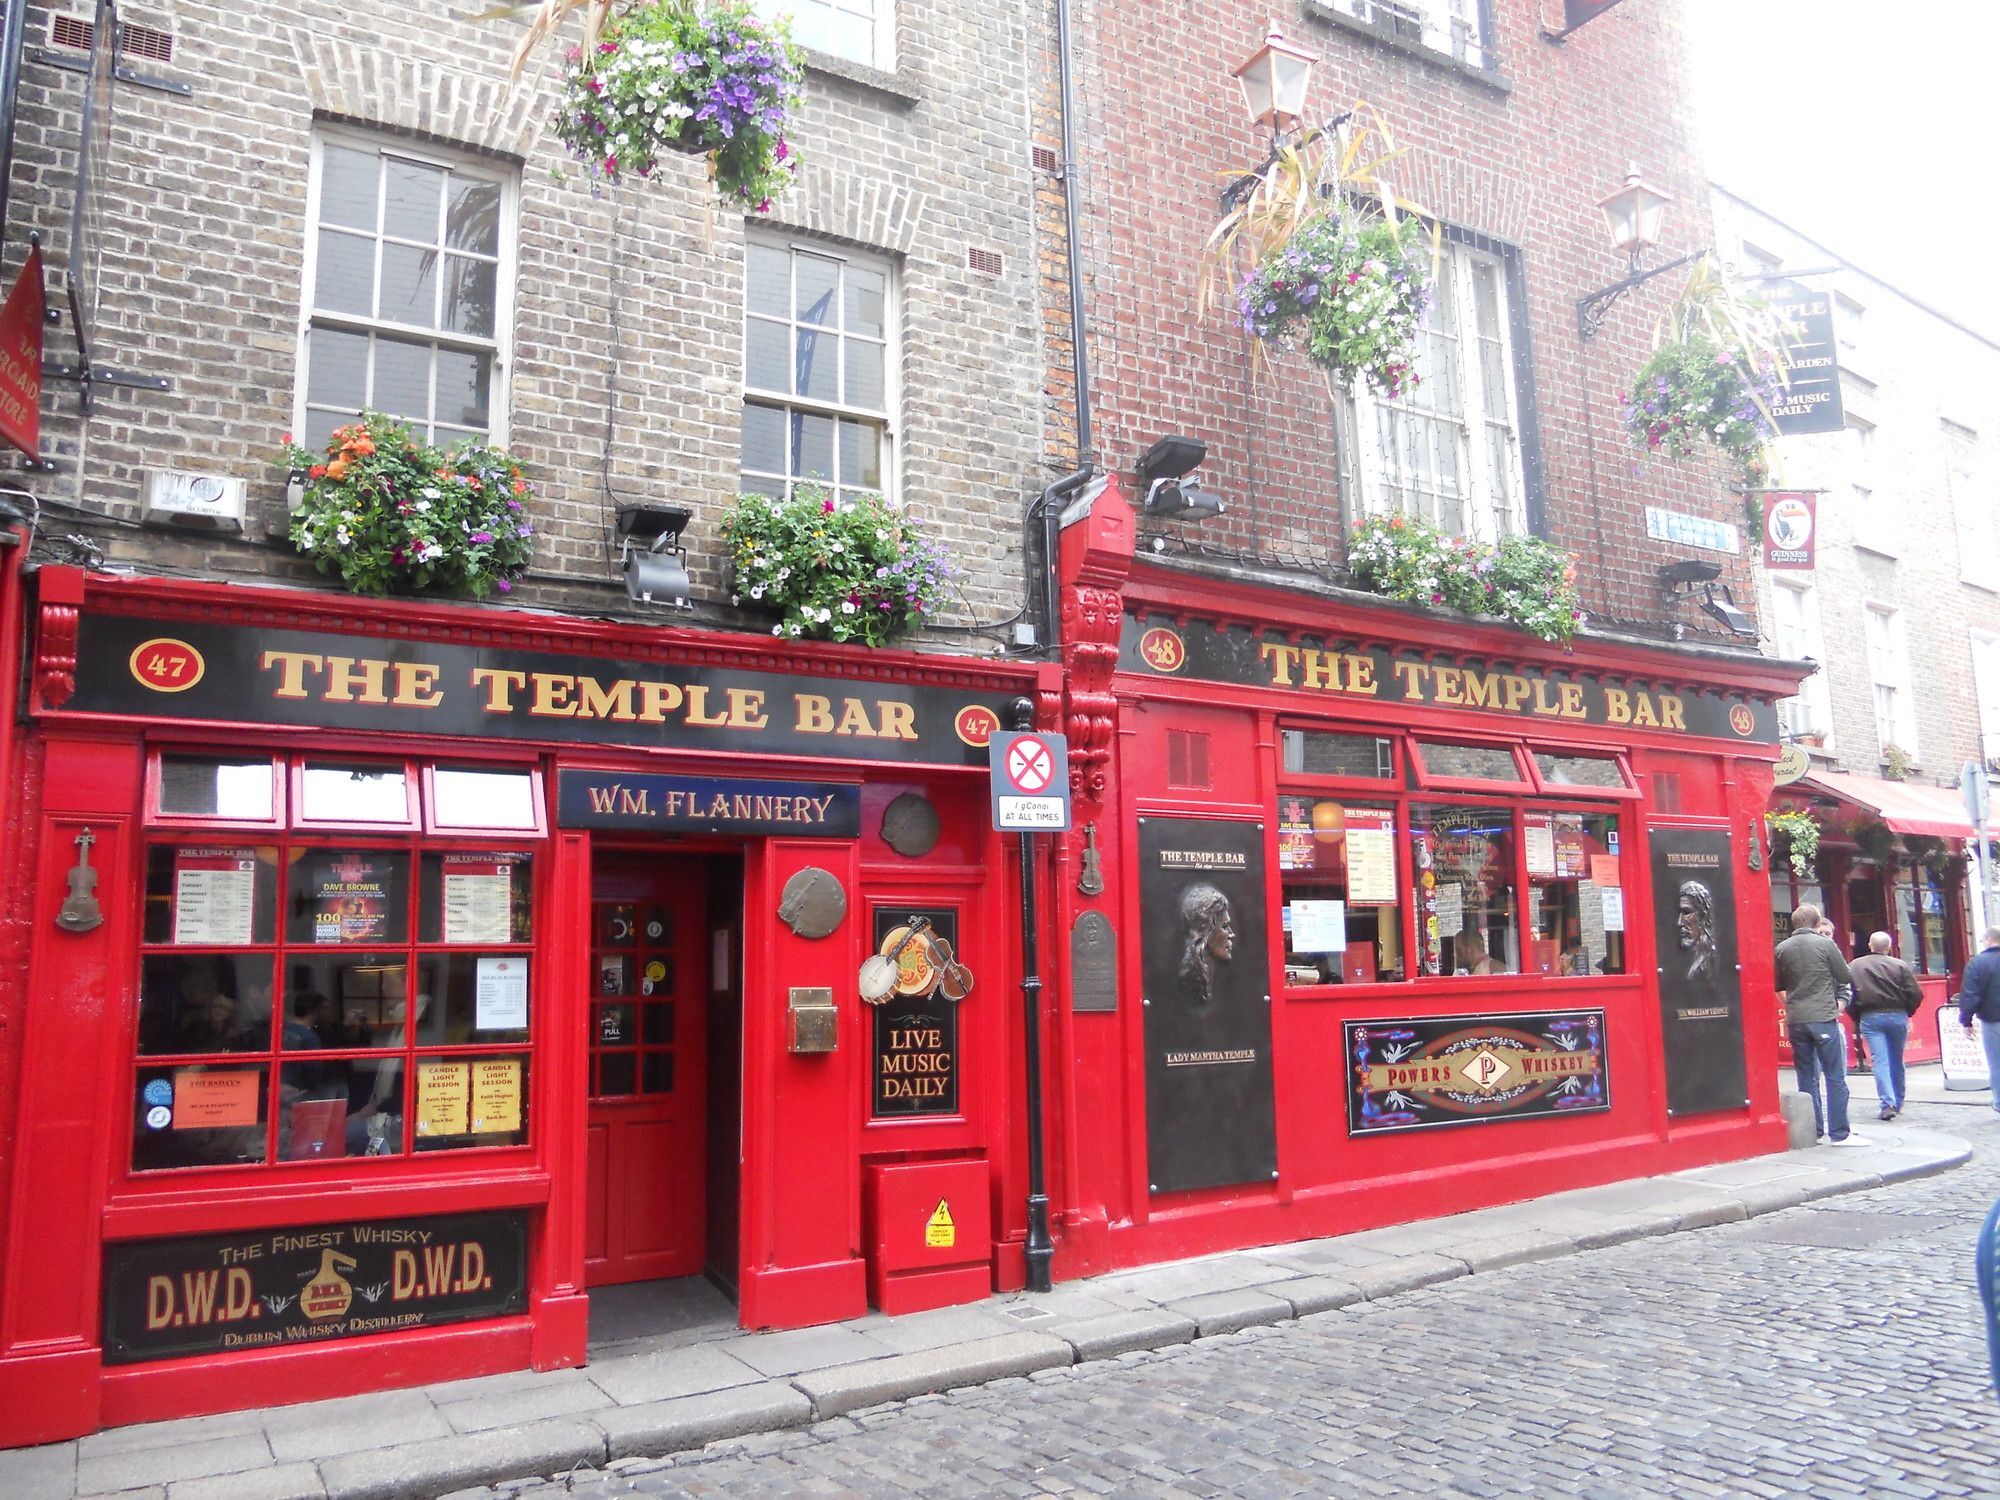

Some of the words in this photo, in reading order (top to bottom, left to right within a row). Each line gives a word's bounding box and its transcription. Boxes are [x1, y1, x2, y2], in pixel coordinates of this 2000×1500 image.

[1787, 393, 1830, 406] MUSIC
[1772, 404, 1812, 416] DAILY
[1771, 550, 1808, 558] GUINNESS
[1148, 637, 1176, 665] 48
[147, 653, 187, 678] 47
[260, 650, 445, 709] THE
[470, 668, 769, 729] TEMPLE
[794, 693, 919, 740] BAR
[1260, 643, 1378, 694] THE
[1394, 661, 1587, 719] TEMPLE
[1604, 688, 1686, 730] BAR
[965, 717, 990, 736] 47
[1733, 709, 1749, 730] 48
[589, 783, 657, 816] WM.
[665, 790, 835, 824] FLANNERY
[1005, 812, 1015, 820] AT
[1018, 812, 1033, 821] ALL
[1036, 813, 1060, 821] TIMES
[1160, 851, 1182, 862] THE
[1183, 851, 1224, 863] TEMPLE
[1225, 853, 1246, 864] BAR
[1680, 853, 1706, 863] TEMPLE
[323, 883, 344, 891] DAVE
[346, 883, 380, 891] BROWNE
[316, 913, 341, 923] 100
[891, 1029, 942, 1049] LIVE
[881, 1053, 950, 1074] MUSIC
[1167, 1053, 1189, 1063] LADY
[1190, 1051, 1224, 1061] MARTHA
[1224, 1049, 1255, 1059] TEMPLE
[1387, 1065, 1452, 1086] POWERS
[1480, 1056, 1495, 1085] P
[1521, 1055, 1584, 1075] WHISKEY
[427, 1081, 460, 1089] SESSION
[883, 1077, 949, 1098] DAILY
[219, 1243, 264, 1265] THE
[272, 1231, 345, 1253] FINEST
[353, 1226, 432, 1244] WHISKY
[147, 1267, 260, 1330] D.W.D.
[393, 1242, 491, 1301] D.W.D.
[225, 1332, 282, 1347] DUBLIN
[286, 1323, 347, 1339] WHISKY
[350, 1313, 424, 1331] DISTILLERY
